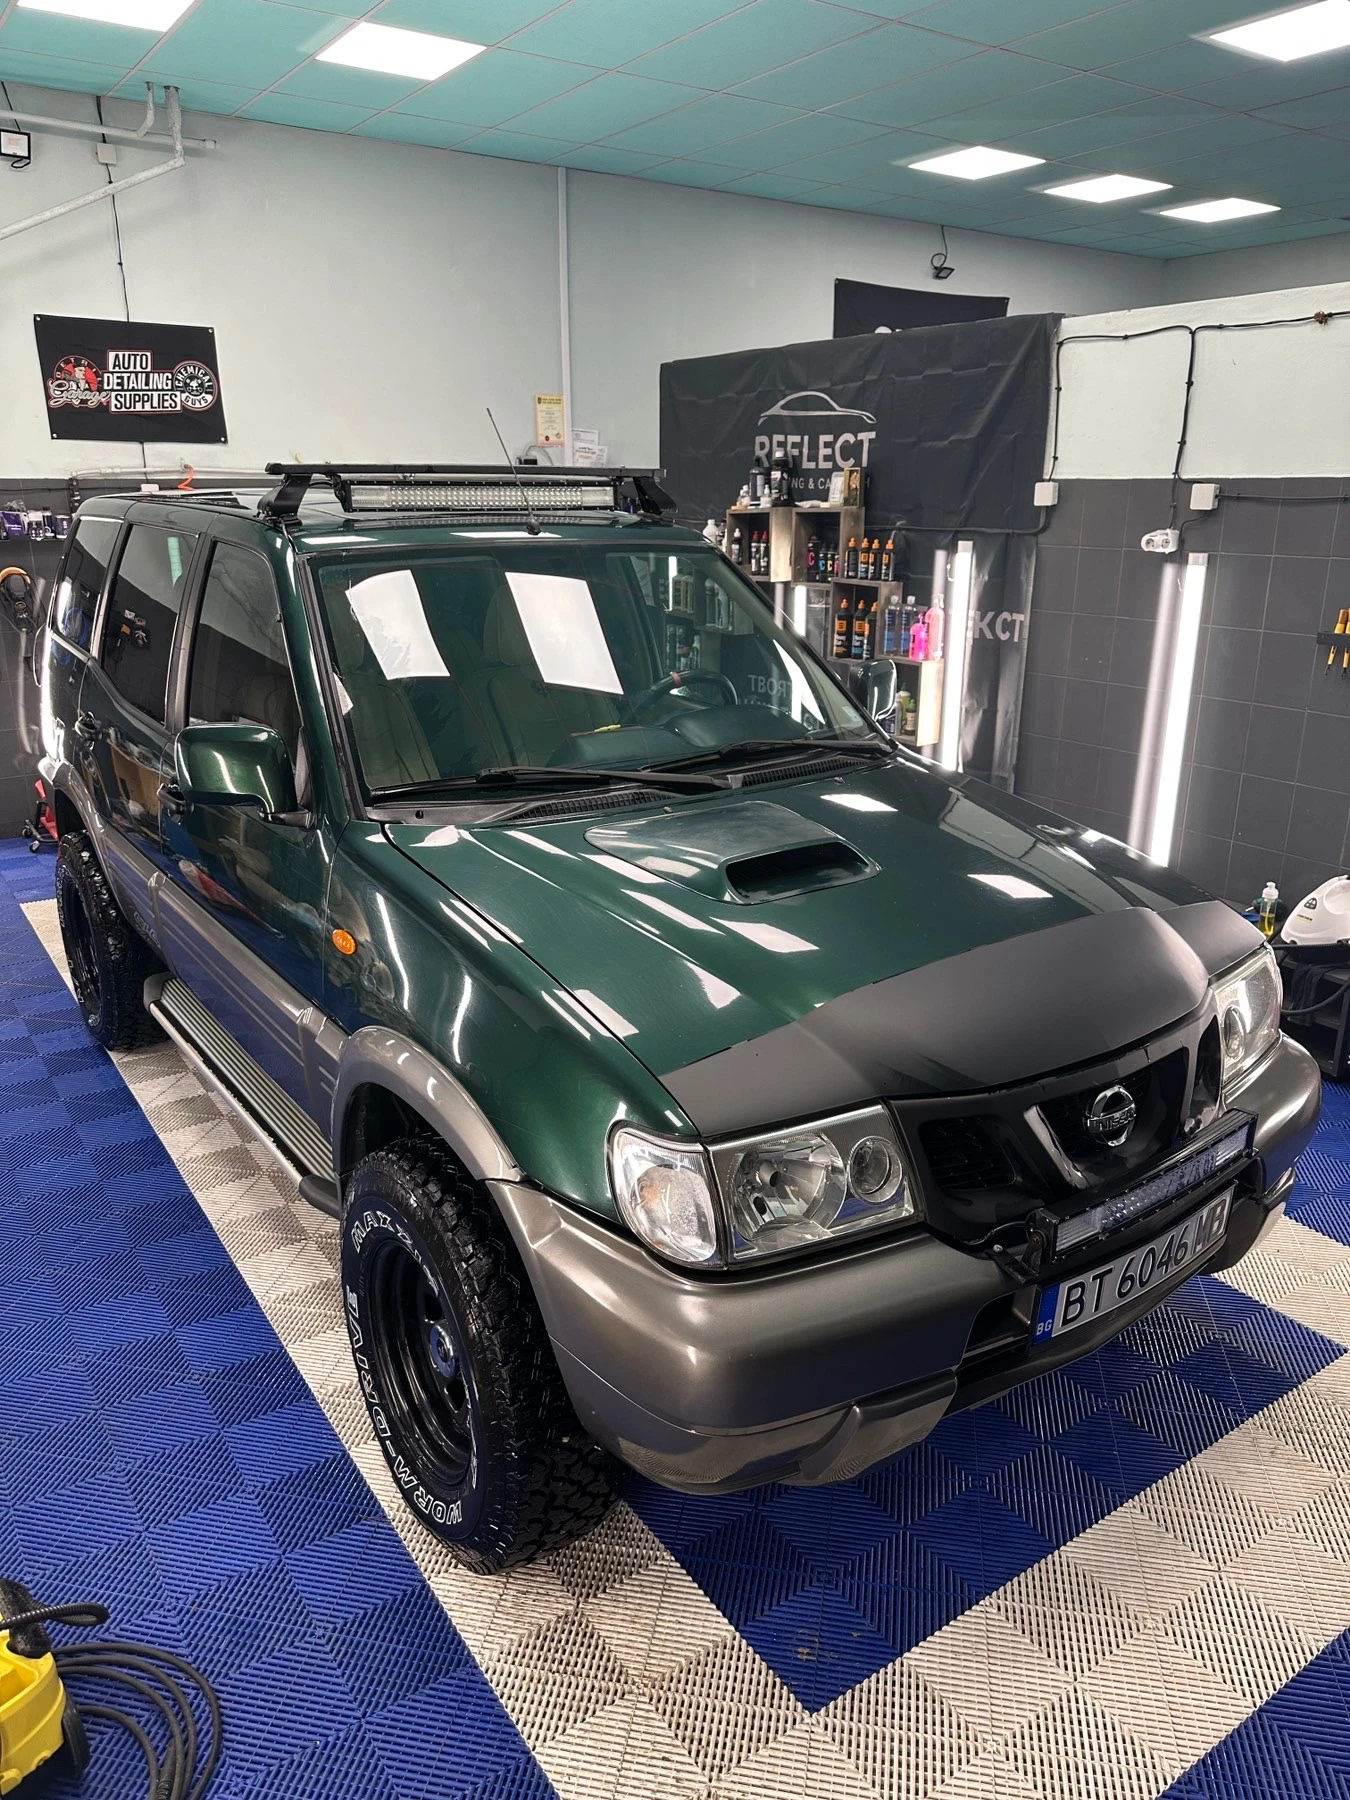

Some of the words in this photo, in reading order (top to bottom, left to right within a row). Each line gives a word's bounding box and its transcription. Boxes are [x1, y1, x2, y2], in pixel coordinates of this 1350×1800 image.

[112, 353, 149, 370] AUTO
[103, 372, 172, 390] DETAILING
[175, 365, 213, 388] CHEMICAL
[49, 379, 110, 406] Garage
[114, 393, 178, 410] SUPPLIES
[184, 395, 208, 406] GUYS
[755, 431, 877, 469] REFLECT
[1098, 1107, 1136, 1131] NISSAN
[1061, 1266, 1114, 1328] BT
[1116, 1221, 1191, 1299] 6046
[1192, 1198, 1228, 1255] MB
[1036, 1319, 1054, 1336] BG
